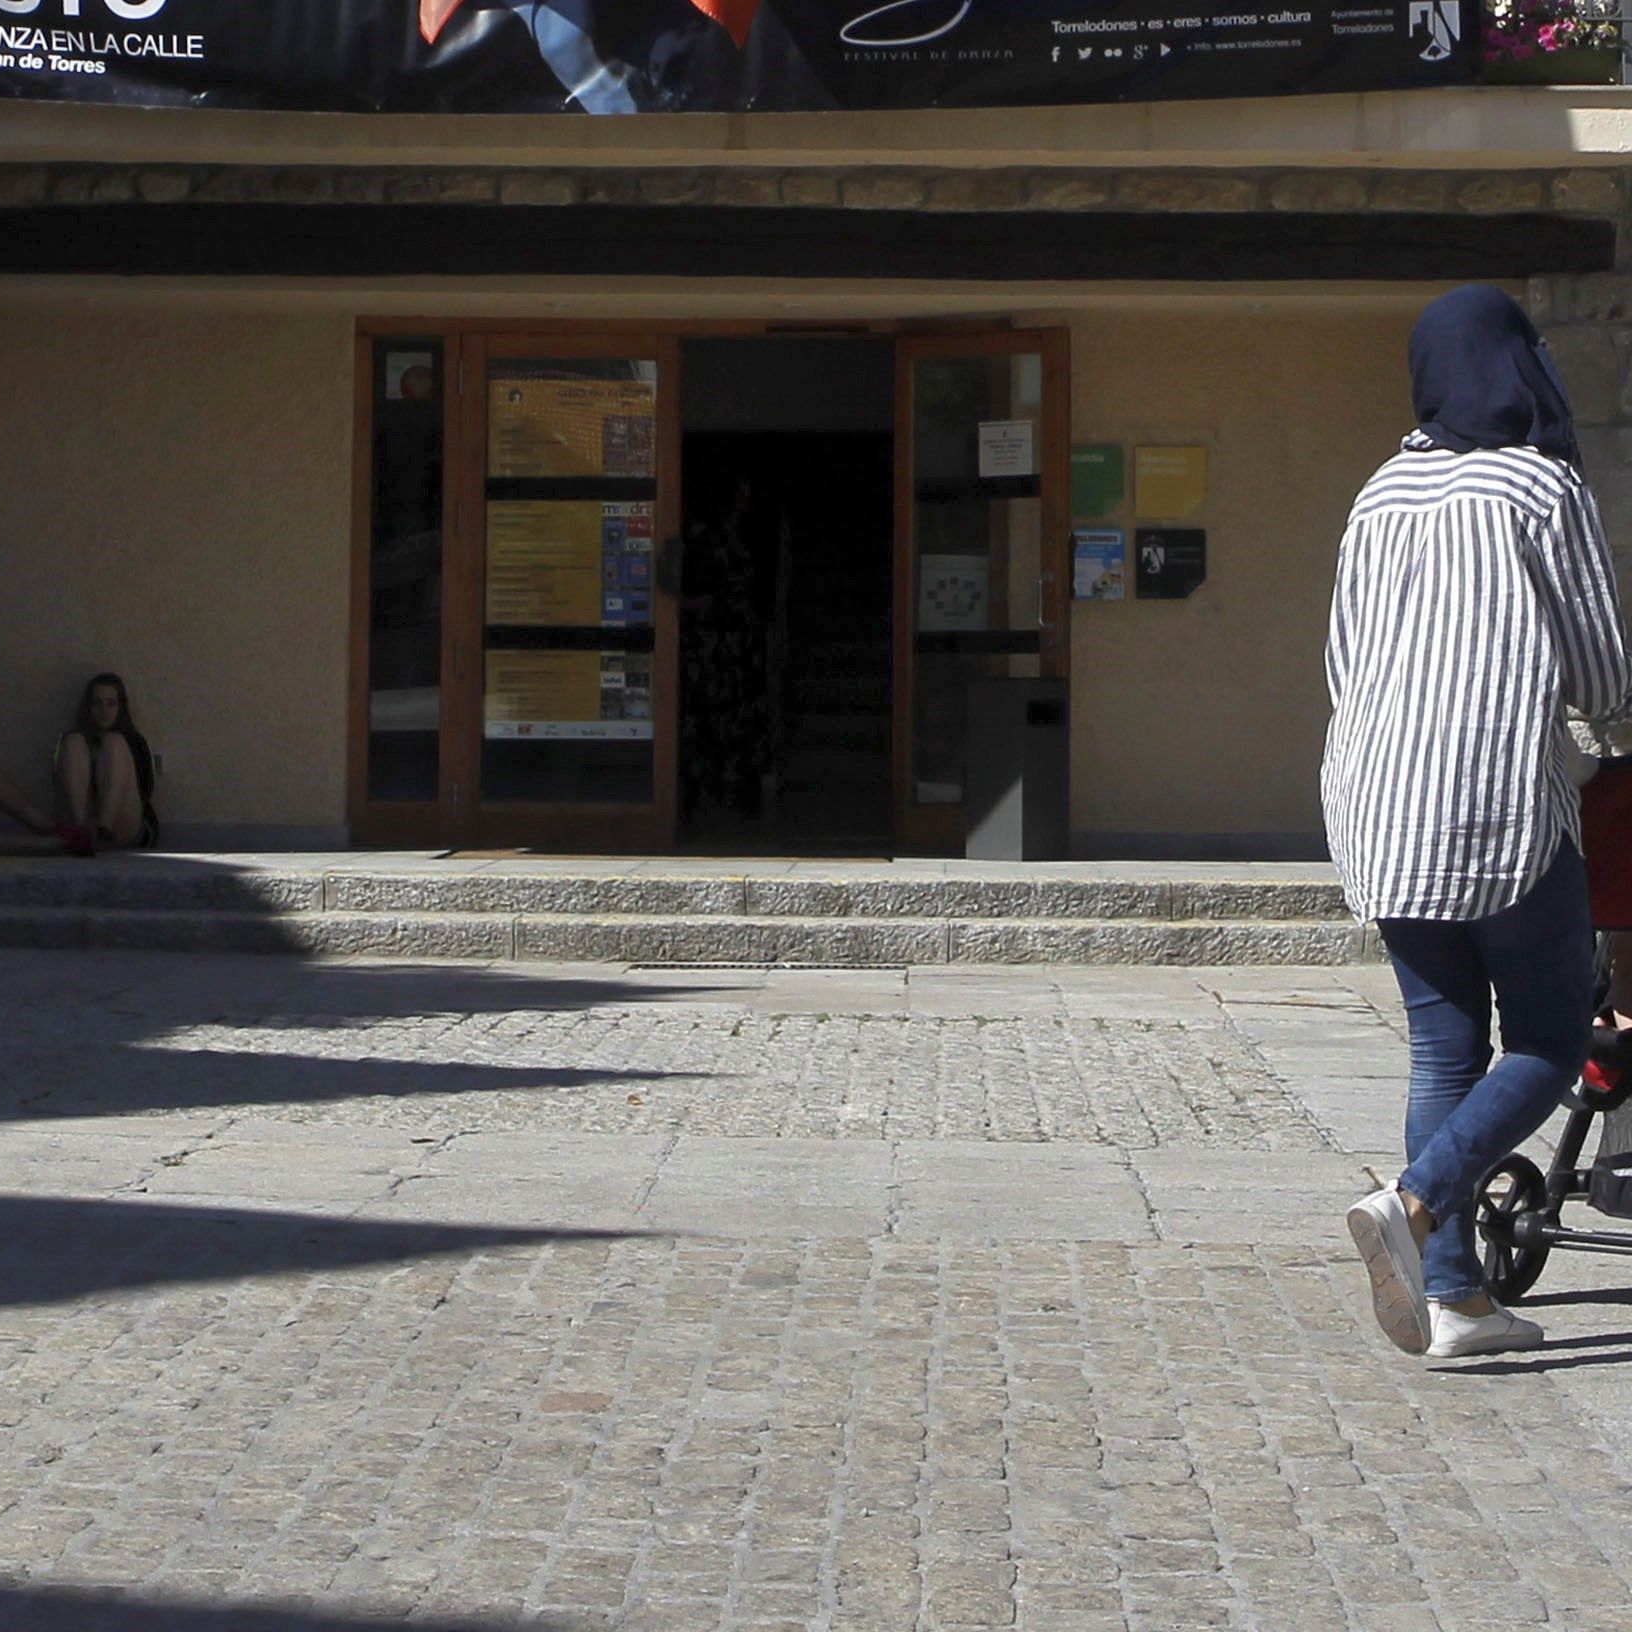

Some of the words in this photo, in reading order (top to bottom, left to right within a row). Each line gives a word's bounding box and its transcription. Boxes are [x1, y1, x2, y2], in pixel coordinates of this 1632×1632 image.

[1051, 20, 1137, 34] Torrelodones
[1147, 19, 1164, 30] es
[1173, 17, 1202, 28] eres
[1212, 14, 1258, 27] somos
[1268, 10, 1312, 24] cultura
[1330, 24, 1395, 35] Torrelodones
[51, 30, 86, 52] EN
[89, 32, 121, 55] LA
[123, 33, 204, 58] CALLE
[19, 53, 43, 70] de
[48, 54, 106, 74] Torres
[843, 50, 919, 61] FESTIVAL
[929, 49, 951, 60] DE
